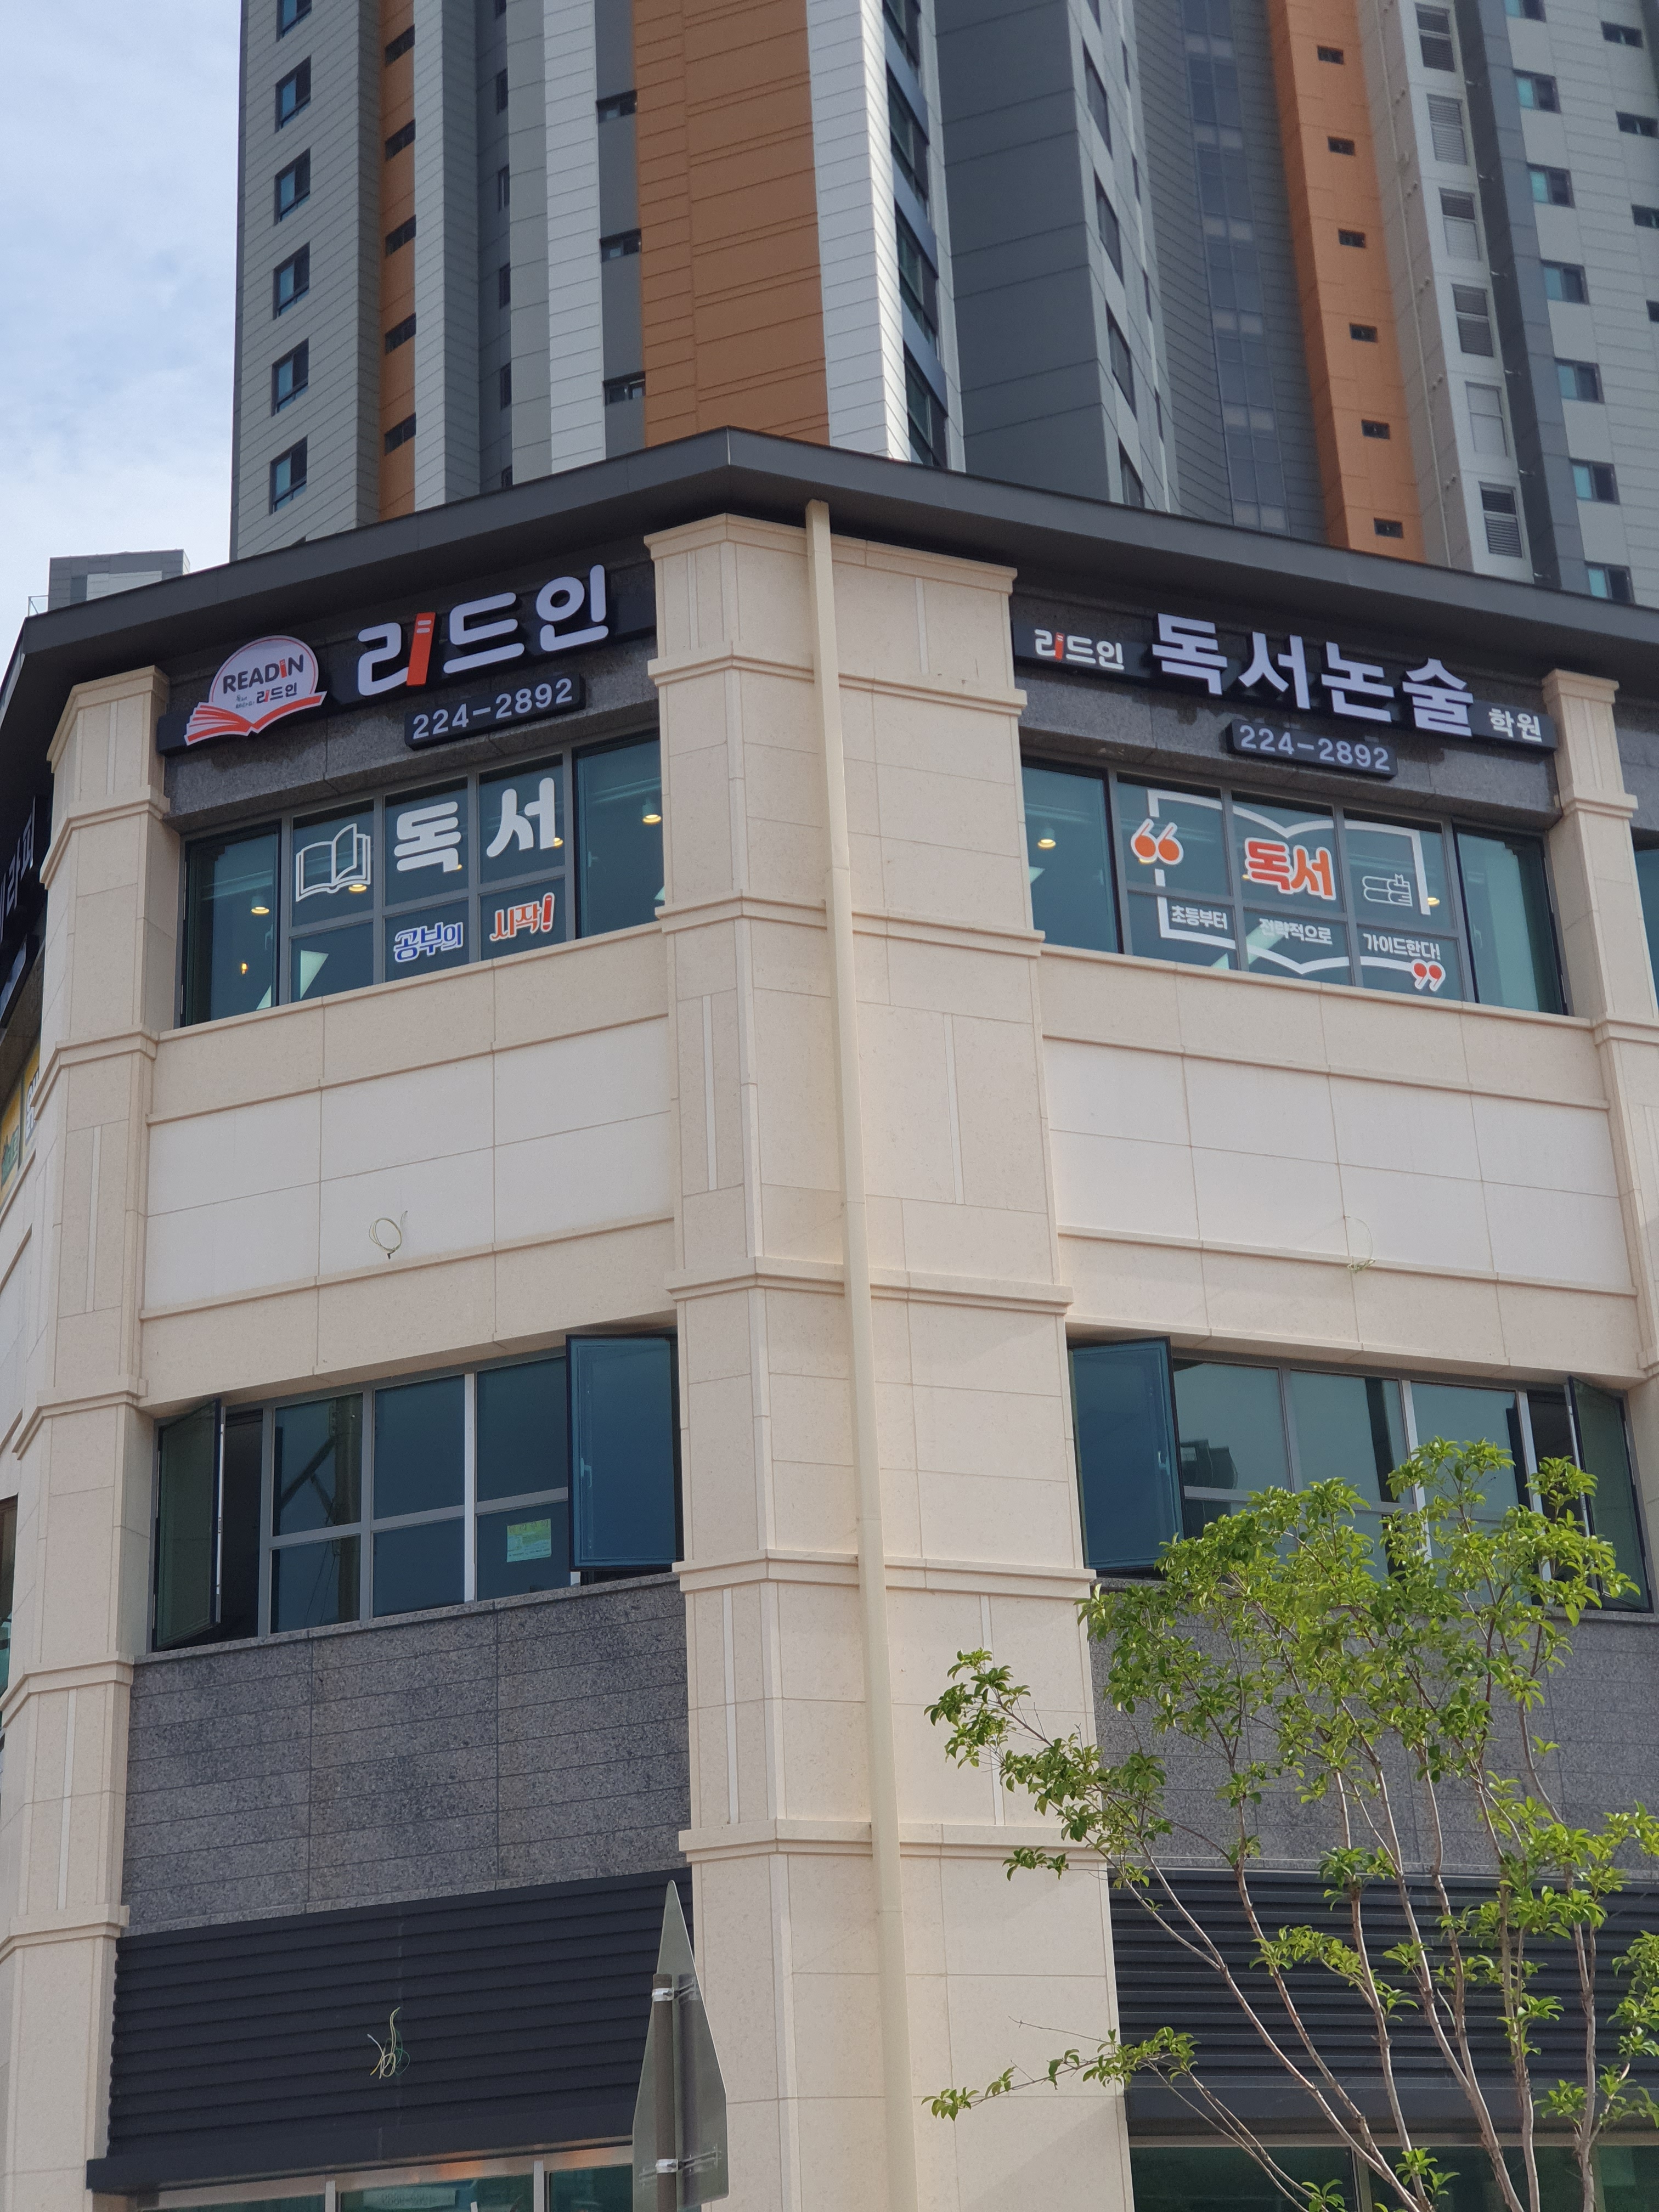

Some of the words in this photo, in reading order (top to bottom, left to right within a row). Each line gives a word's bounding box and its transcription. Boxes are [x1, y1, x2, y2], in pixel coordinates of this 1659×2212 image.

[358, 564, 610, 697] 리드인
[223, 653, 304, 694] READIN
[256, 682, 297, 704] 리드인
[1034, 628, 1125, 671] 리드인
[1152, 612, 1474, 737] 독서논술
[1488, 707, 1543, 743] 학원
[412, 678, 572, 740] 224-2892
[1239, 724, 1390, 771] 224-2892
[393, 777, 555, 873] 독서
[1244, 838, 1337, 901] 독서
[393, 922, 464, 963] 공부의
[489, 892, 555, 942] 시작!
[1171, 905, 1228, 930] 초등부터
[1259, 918, 1333, 945] 전략적으로
[1363, 933, 1441, 961] 가이드한다!
